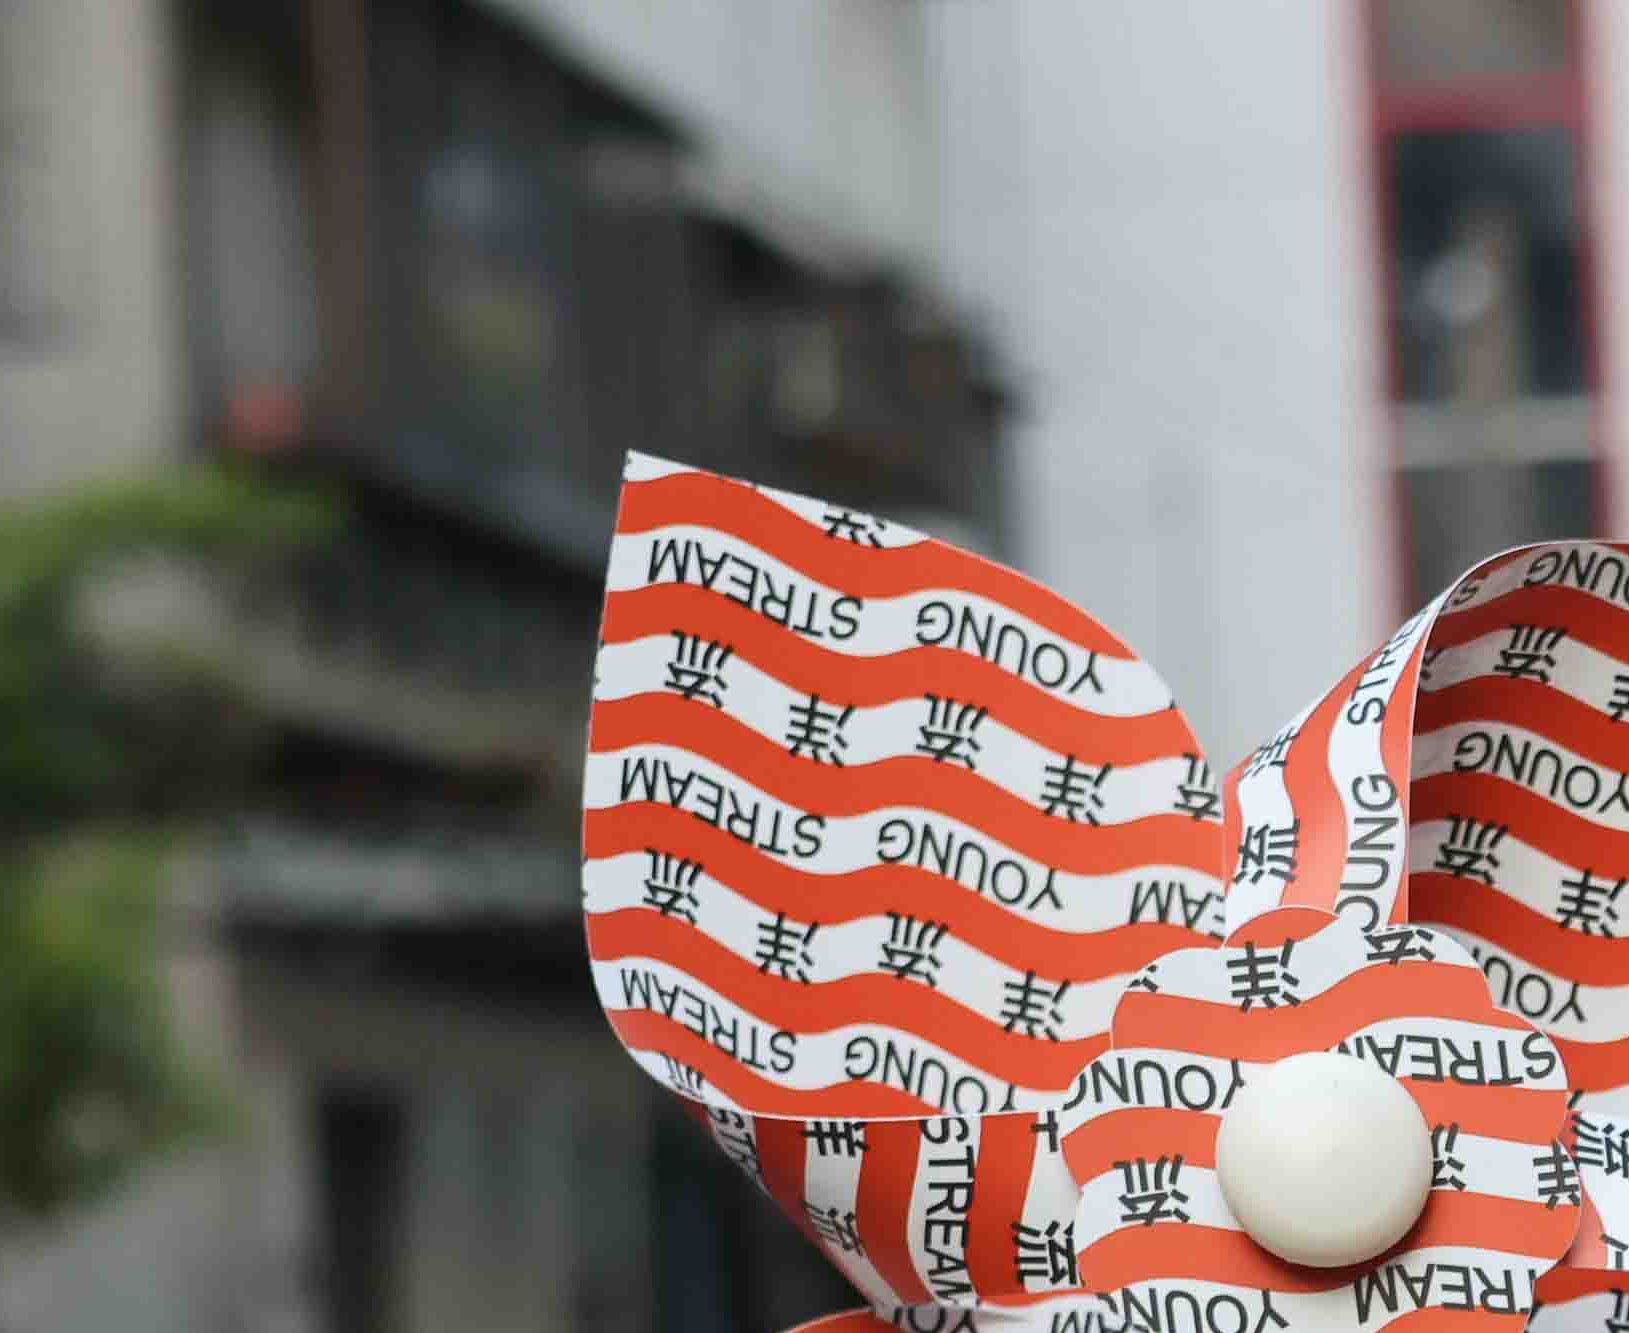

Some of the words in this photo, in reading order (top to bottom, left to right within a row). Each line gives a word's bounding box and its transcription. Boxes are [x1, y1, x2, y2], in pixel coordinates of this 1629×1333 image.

[648, 539, 862, 640] STREAM
[916, 602, 1102, 693] YOUNG
[621, 758, 825, 858] STREAM
[1334, 774, 1399, 933] OUNG
[877, 820, 1061, 909] YOUNG
[621, 969, 796, 1073] STREAM
[1479, 944, 1588, 1028] YOU
[918, 1116, 978, 1308] STREAM
[1354, 1263, 1537, 1326] TREAM
